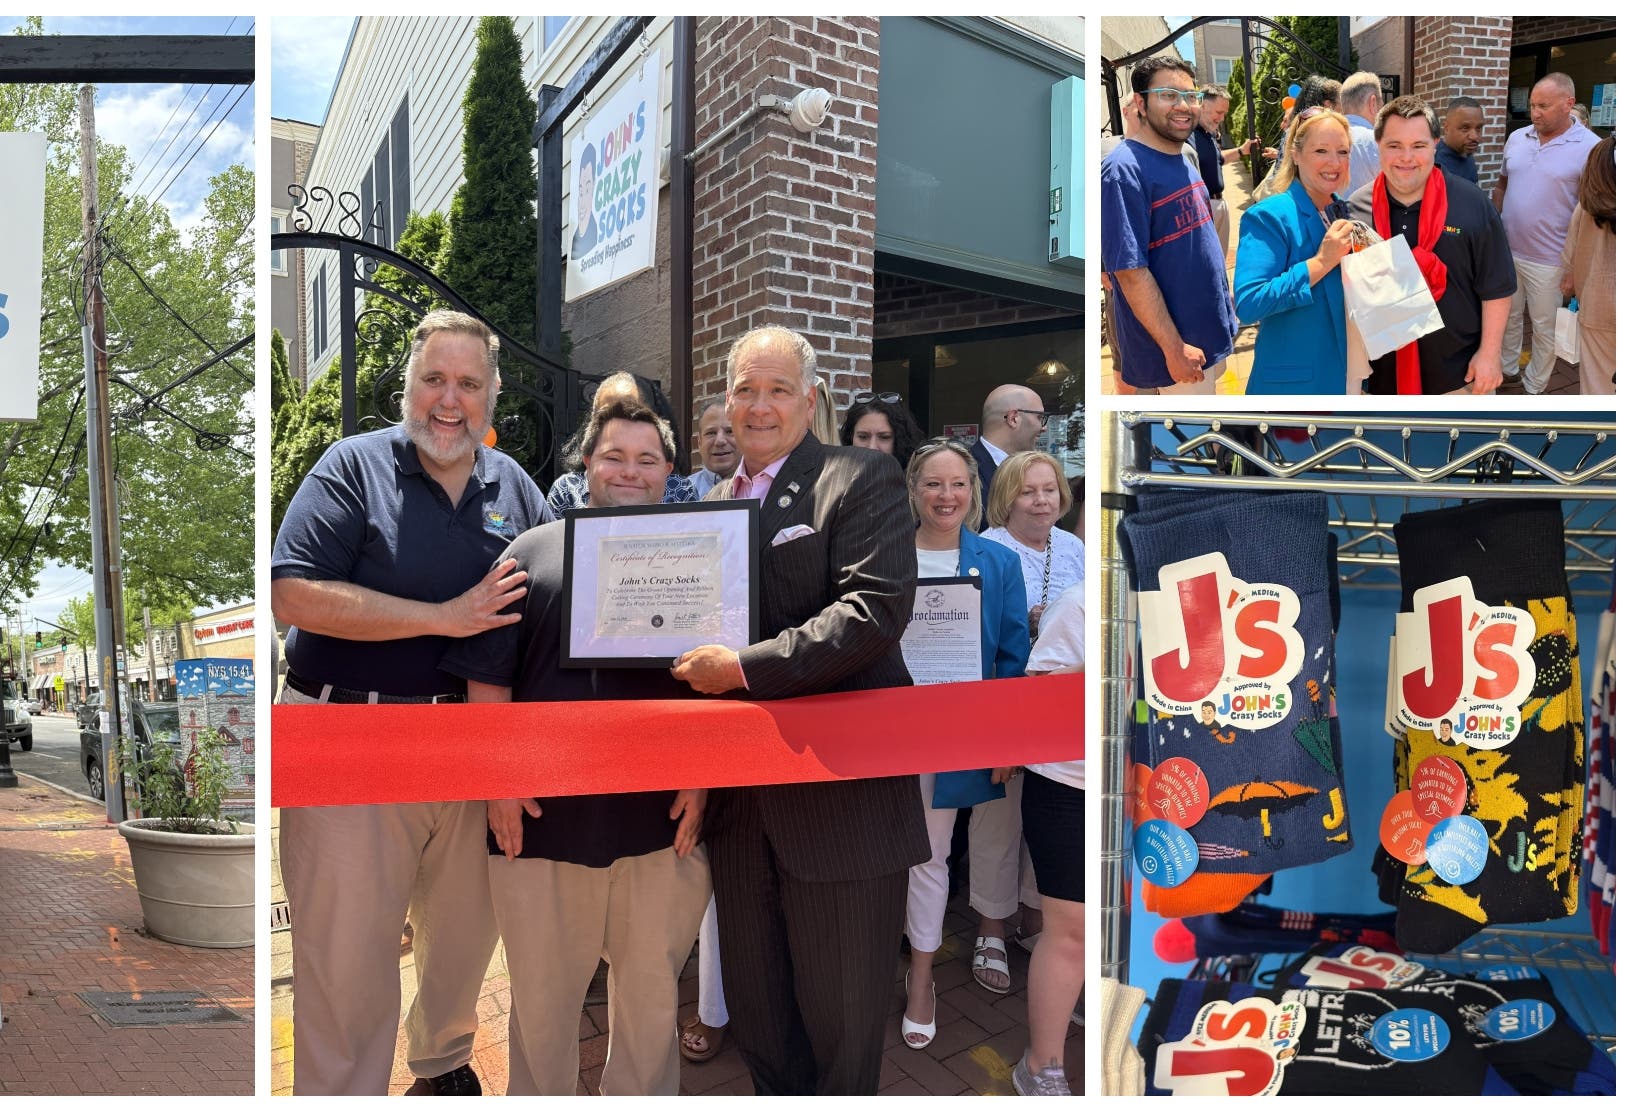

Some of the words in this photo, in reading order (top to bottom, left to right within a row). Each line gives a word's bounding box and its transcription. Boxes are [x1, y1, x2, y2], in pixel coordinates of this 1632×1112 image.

[597, 101, 646, 177] JOHN'S
[594, 148, 643, 213] CRAZY
[598, 182, 647, 244] SOCKS
[619, 577, 647, 586] John's
[650, 576, 673, 586] Crazy
[676, 575, 700, 584] Socks
[1251, 589, 1280, 599] MEDIUM
[910, 608, 969, 621] roclamation
[1491, 612, 1517, 621] MEDIUM
[1233, 682, 1262, 692] Approved
[1264, 682, 1272, 691] by
[1151, 694, 1167, 708] Made
[1175, 704, 1192, 712] China
[1218, 693, 1286, 716] JOHN'S
[1469, 704, 1495, 712] Approved
[1496, 704, 1502, 712] by
[1230, 712, 1255, 721] Crazy
[1257, 710, 1282, 719] Socks
[1418, 720, 1433, 728] China
[1454, 712, 1515, 733] JOHN'S
[1464, 731, 1486, 741] Crazy
[1488, 732, 1511, 740] Socks
[1273, 1004, 1294, 1048] JOHN'S
[1289, 1018, 1299, 1038] Crazy
[1314, 993, 1345, 1054] LETR
[1499, 1008, 1519, 1034] 10%
[1388, 1019, 1411, 1050] 10%
